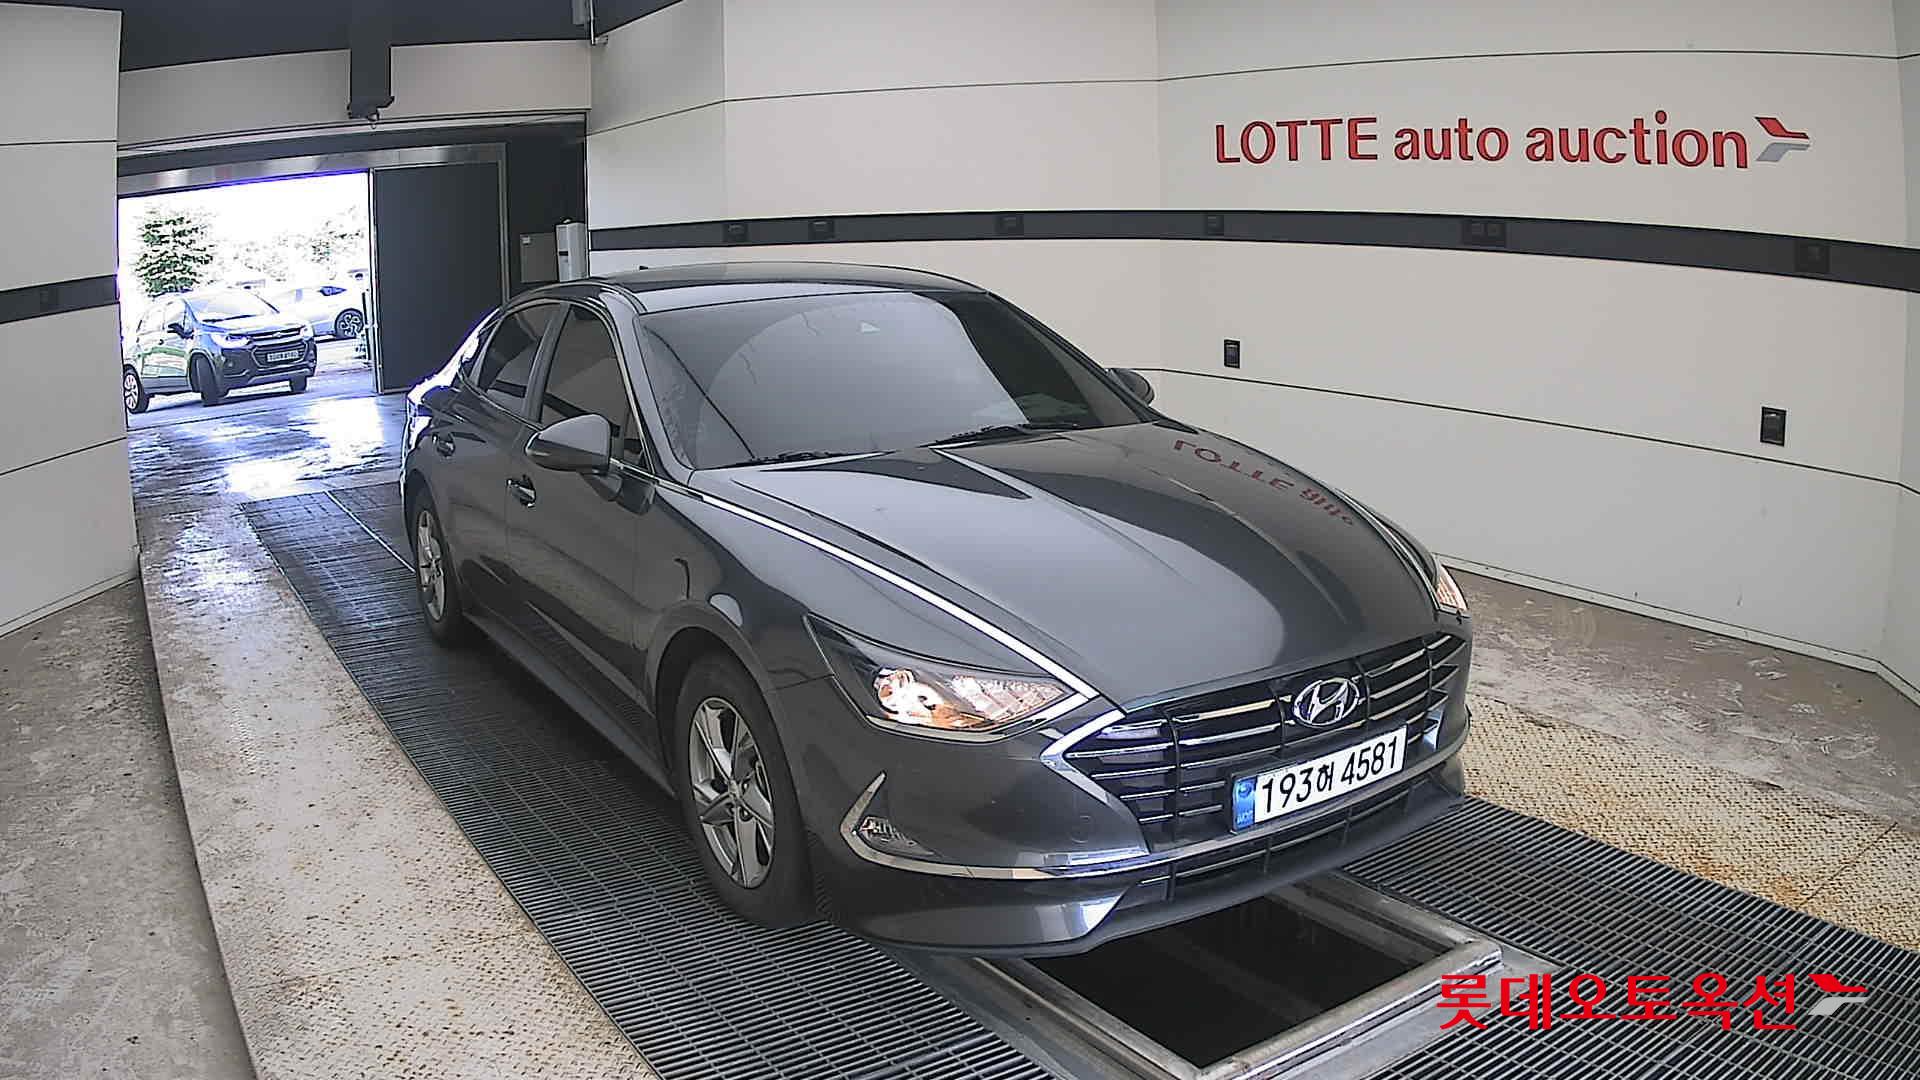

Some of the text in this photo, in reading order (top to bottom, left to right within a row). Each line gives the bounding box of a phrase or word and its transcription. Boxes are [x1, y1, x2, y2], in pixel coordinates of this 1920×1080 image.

[1215, 110, 1749, 169] LOTTE auto auction
[1262, 735, 1398, 813] 193허 4581
